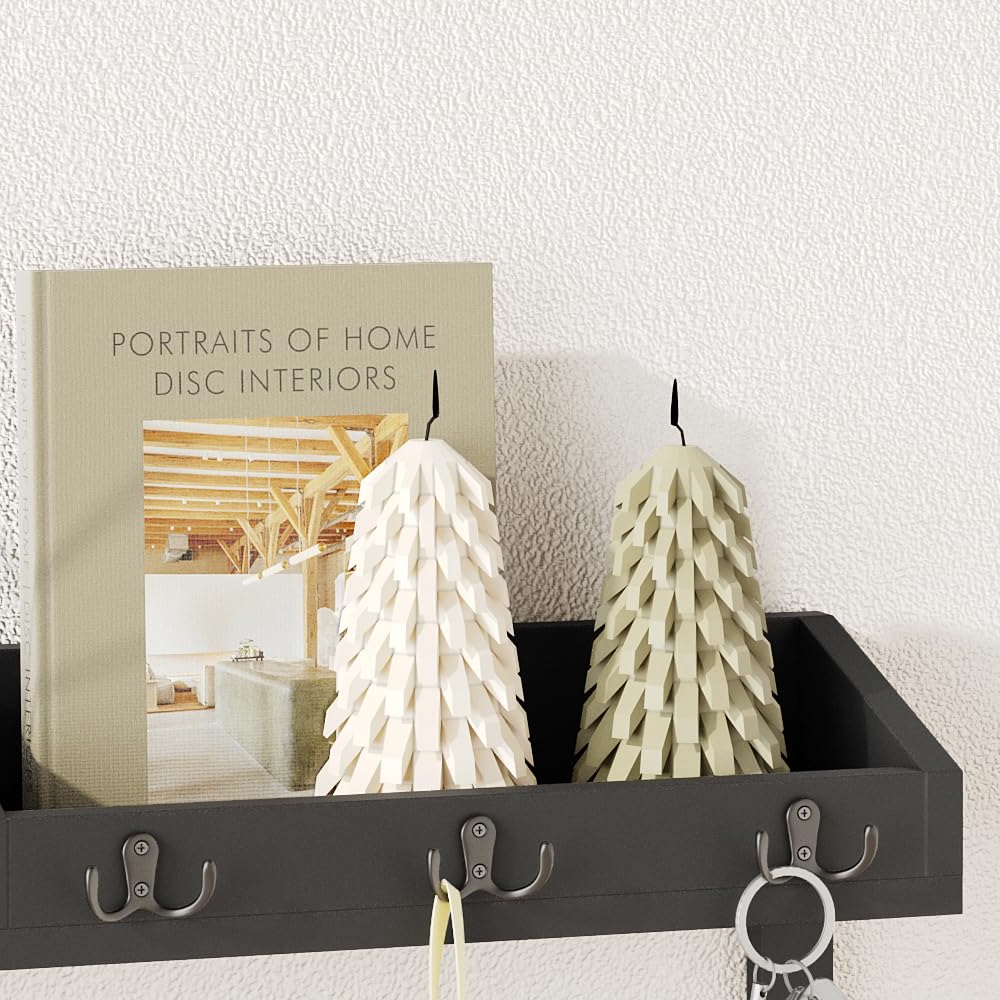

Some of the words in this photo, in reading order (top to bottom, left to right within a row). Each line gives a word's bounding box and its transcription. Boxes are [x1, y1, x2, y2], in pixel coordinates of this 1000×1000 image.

[112, 328, 272, 357] PORTRAITS
[287, 327, 329, 353] OF
[345, 325, 437, 351] HOME
[154, 370, 225, 396] DISC
[240, 365, 397, 394] INTERIORS
